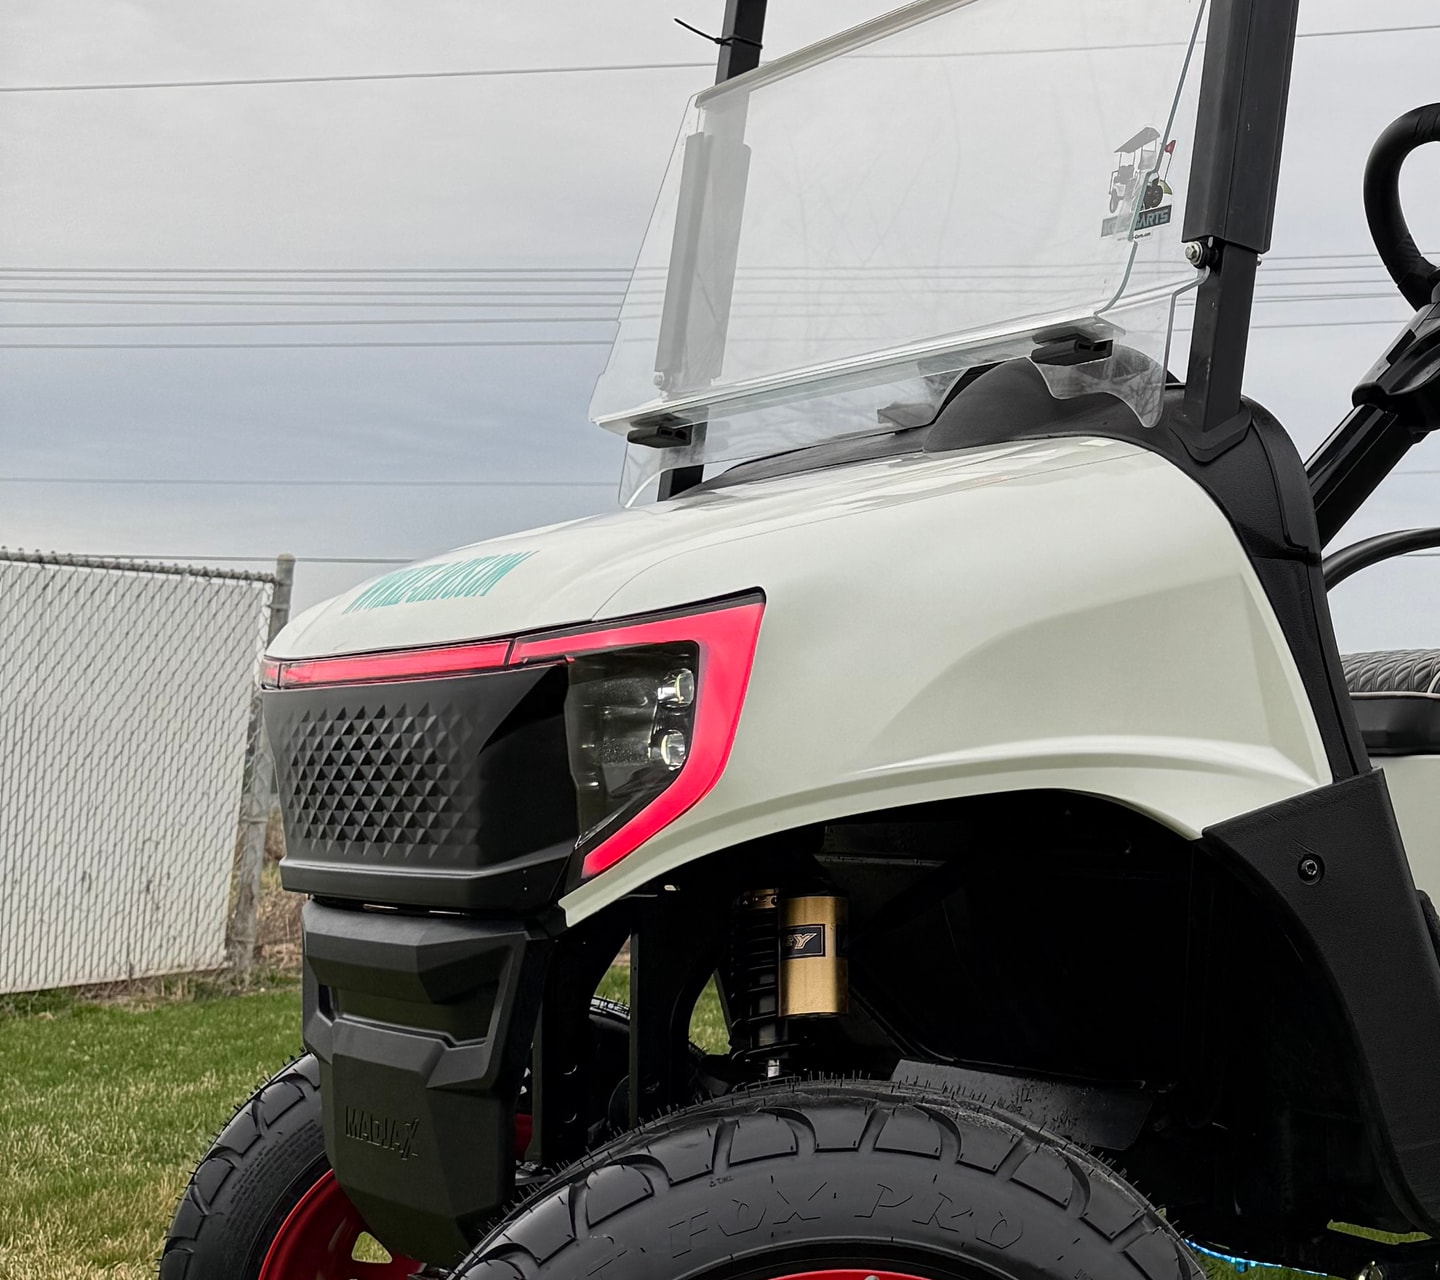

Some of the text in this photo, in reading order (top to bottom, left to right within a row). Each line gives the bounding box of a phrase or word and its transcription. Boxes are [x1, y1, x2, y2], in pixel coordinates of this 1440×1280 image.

[346, 1106, 420, 1160] MADJAX
[668, 1180, 831, 1259] FOX
[853, 1182, 1024, 1250] PRO
